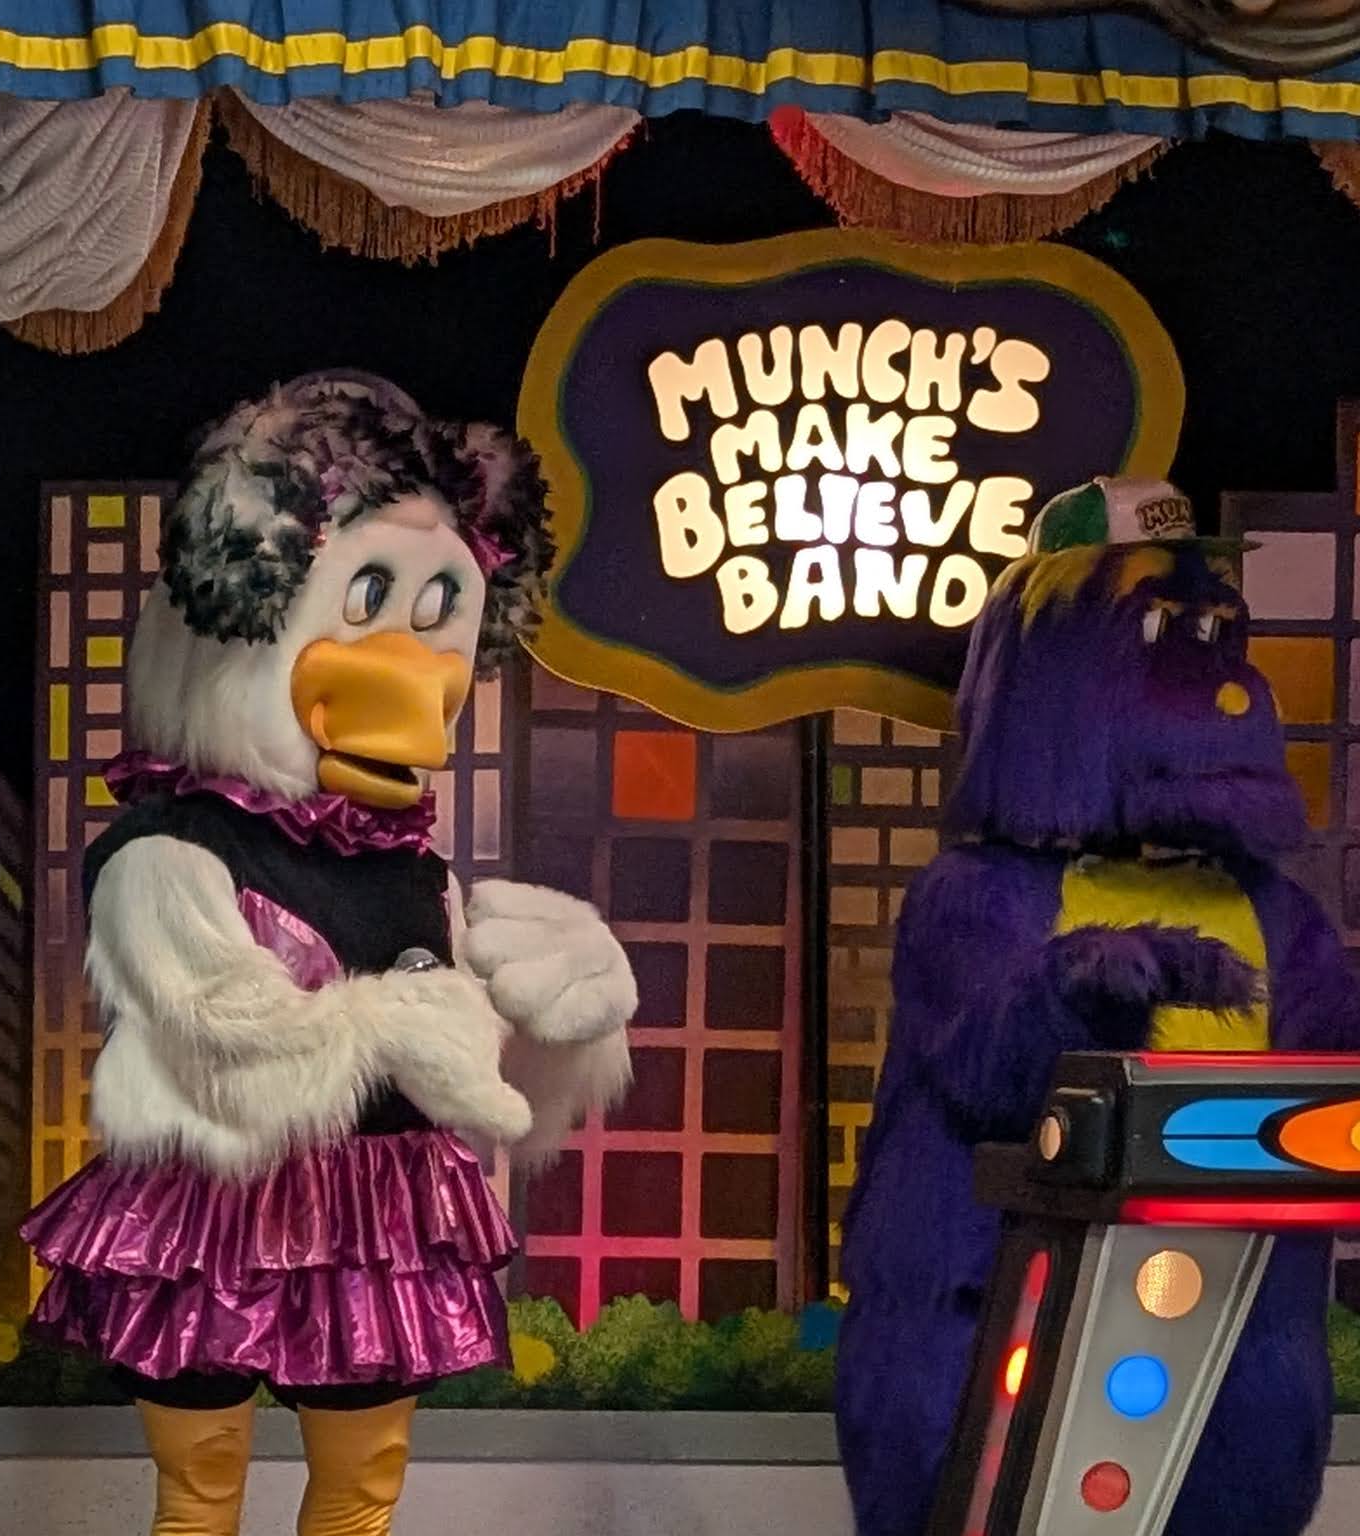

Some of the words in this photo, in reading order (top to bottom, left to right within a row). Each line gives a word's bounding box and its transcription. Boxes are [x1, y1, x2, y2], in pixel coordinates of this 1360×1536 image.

[647, 319, 1051, 441] MUNCH'S
[709, 403, 958, 486] MAKE
[653, 471, 1035, 579] BELIEVE
[715, 545, 989, 635] BAND
